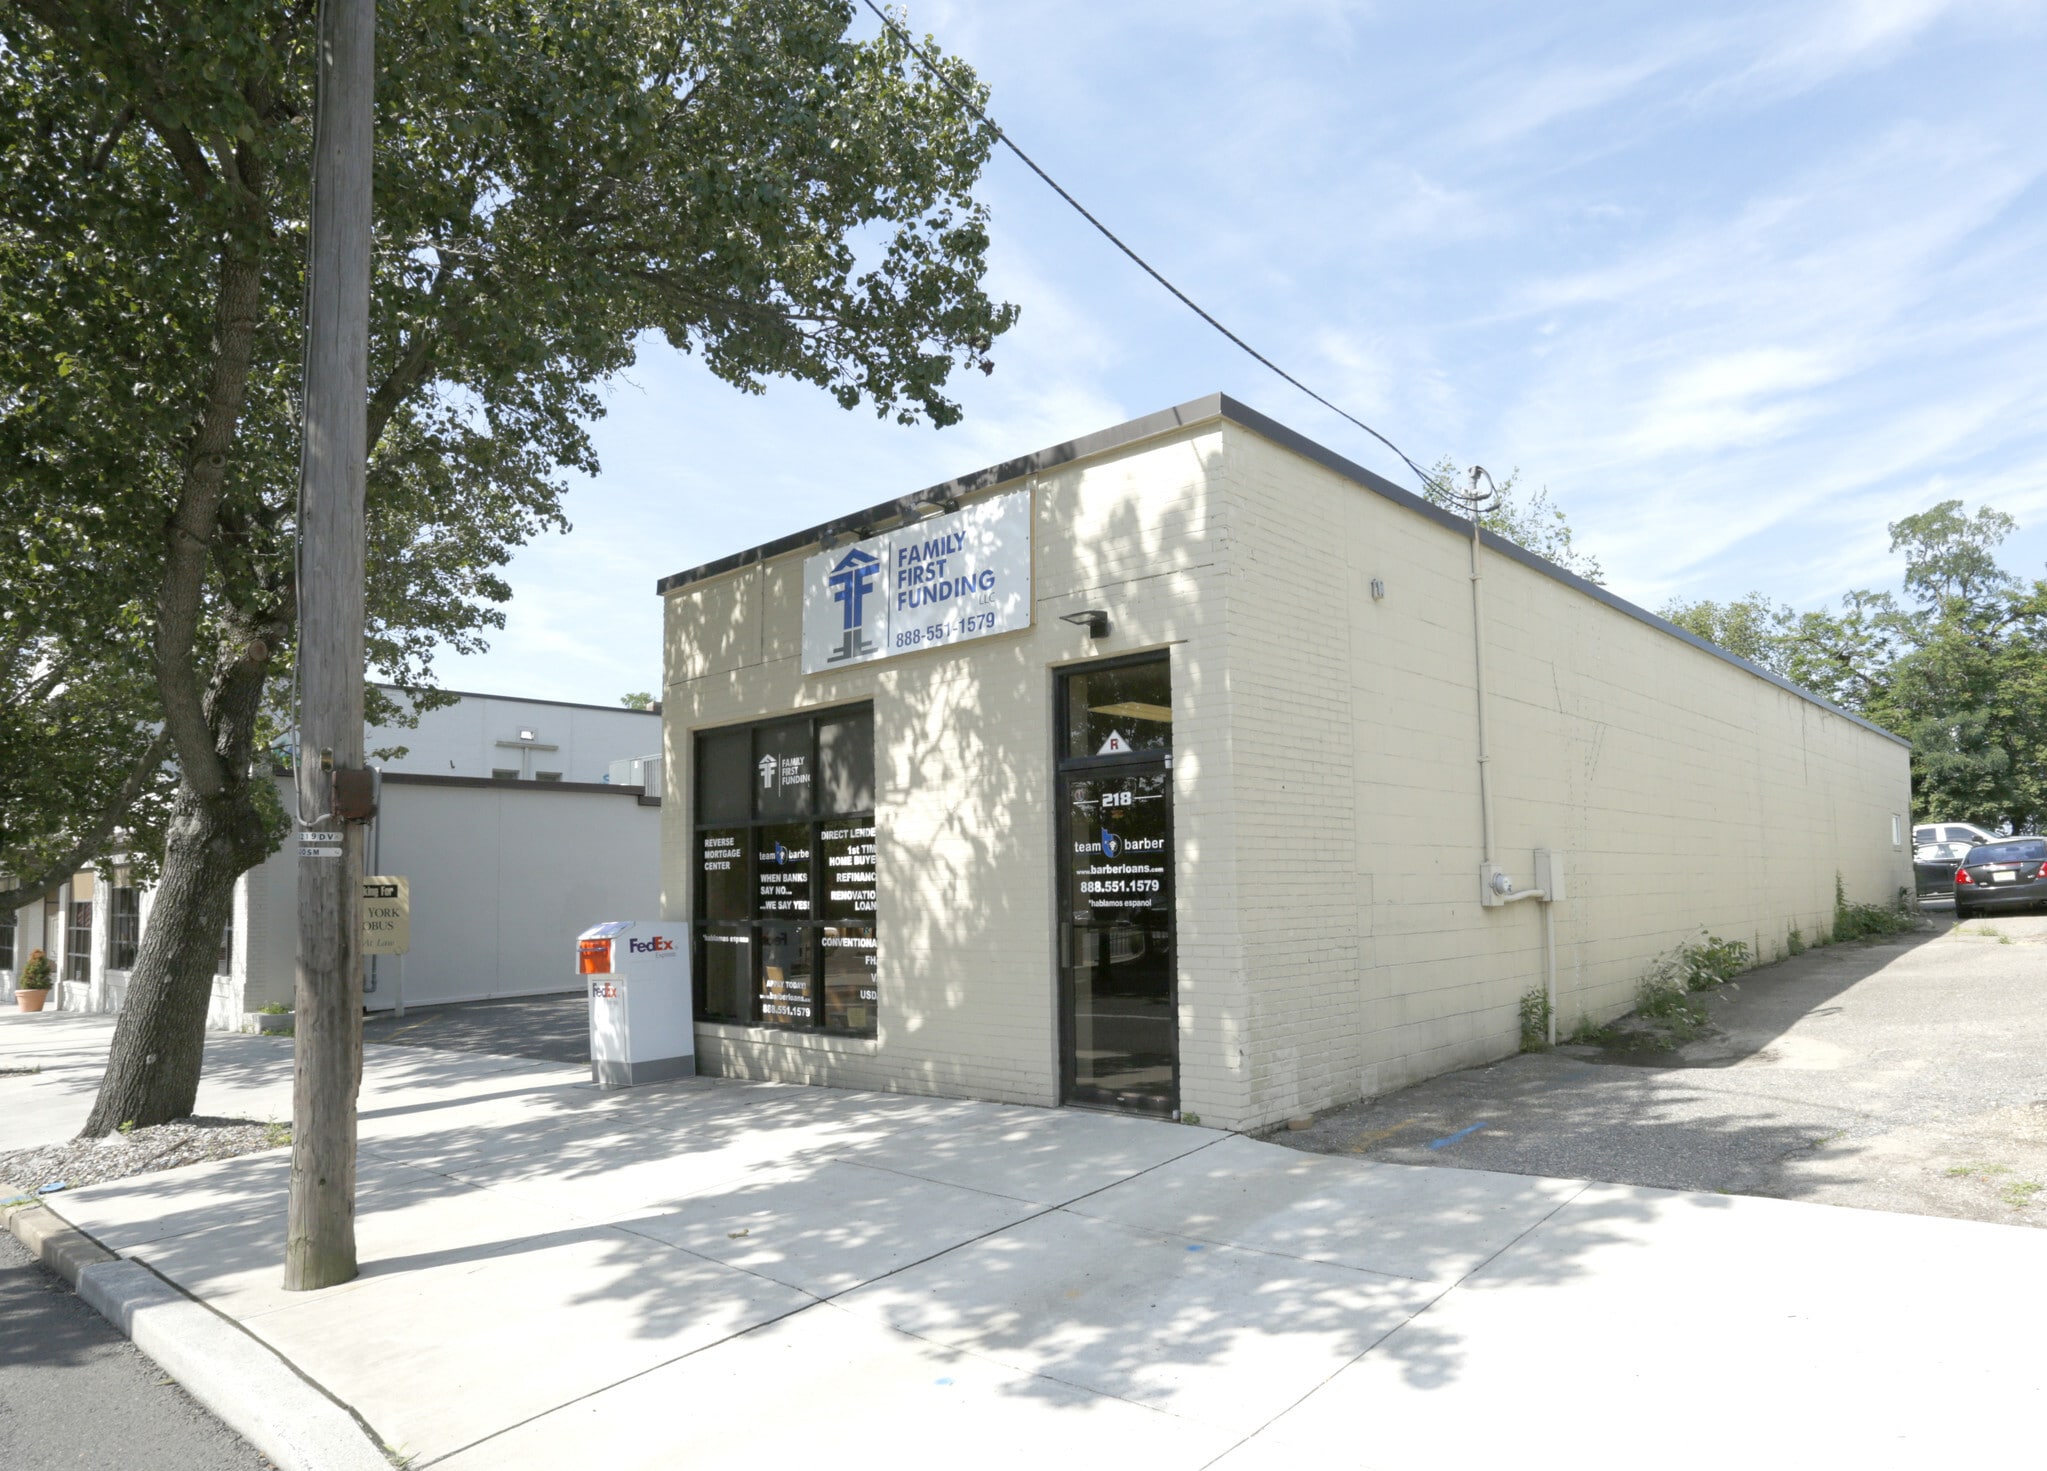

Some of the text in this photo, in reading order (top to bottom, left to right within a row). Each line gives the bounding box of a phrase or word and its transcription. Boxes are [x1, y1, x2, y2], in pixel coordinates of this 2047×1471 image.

[898, 530, 966, 568] FAMILY
[897, 559, 947, 589] FIRST
[897, 569, 995, 611] FUNDING
[978, 594, 996, 605] LLC
[896, 612, 995, 648] 888-551-1579
[1110, 738, 1119, 750] R
[1102, 791, 1131, 807] 218
[820, 827, 876, 840] DIRECT LENDE
[704, 838, 735, 848] REVERSE
[1074, 837, 1164, 853] team barber
[704, 849, 742, 859] MORTGAGE
[759, 849, 810, 861] team barbe
[847, 844, 876, 855] 1st TIM
[704, 861, 731, 871] CENTER
[829, 855, 876, 866] HOME BUYE
[1076, 864, 1164, 875] www.barberloans.com
[760, 873, 808, 883] WHEN BANKS
[836, 872, 876, 882] REFINANC
[760, 886, 775, 895] SAY
[1080, 880, 1159, 893] 888.551.1579
[830, 890, 876, 900] RENOVATIO
[777, 900, 792, 910] SAY
[793, 900, 810, 910] YES!
[855, 901, 877, 911] LOAN
[368, 907, 400, 918] YORK
[362, 921, 394, 931] OBUS
[629, 936, 673, 953] FedEx
[821, 937, 877, 948] CONVENTIONA
[865, 955, 877, 965] FH
[592, 982, 617, 998] FedEx
[860, 989, 877, 1000] USD
[762, 1003, 811, 1017] 888.551.1579
